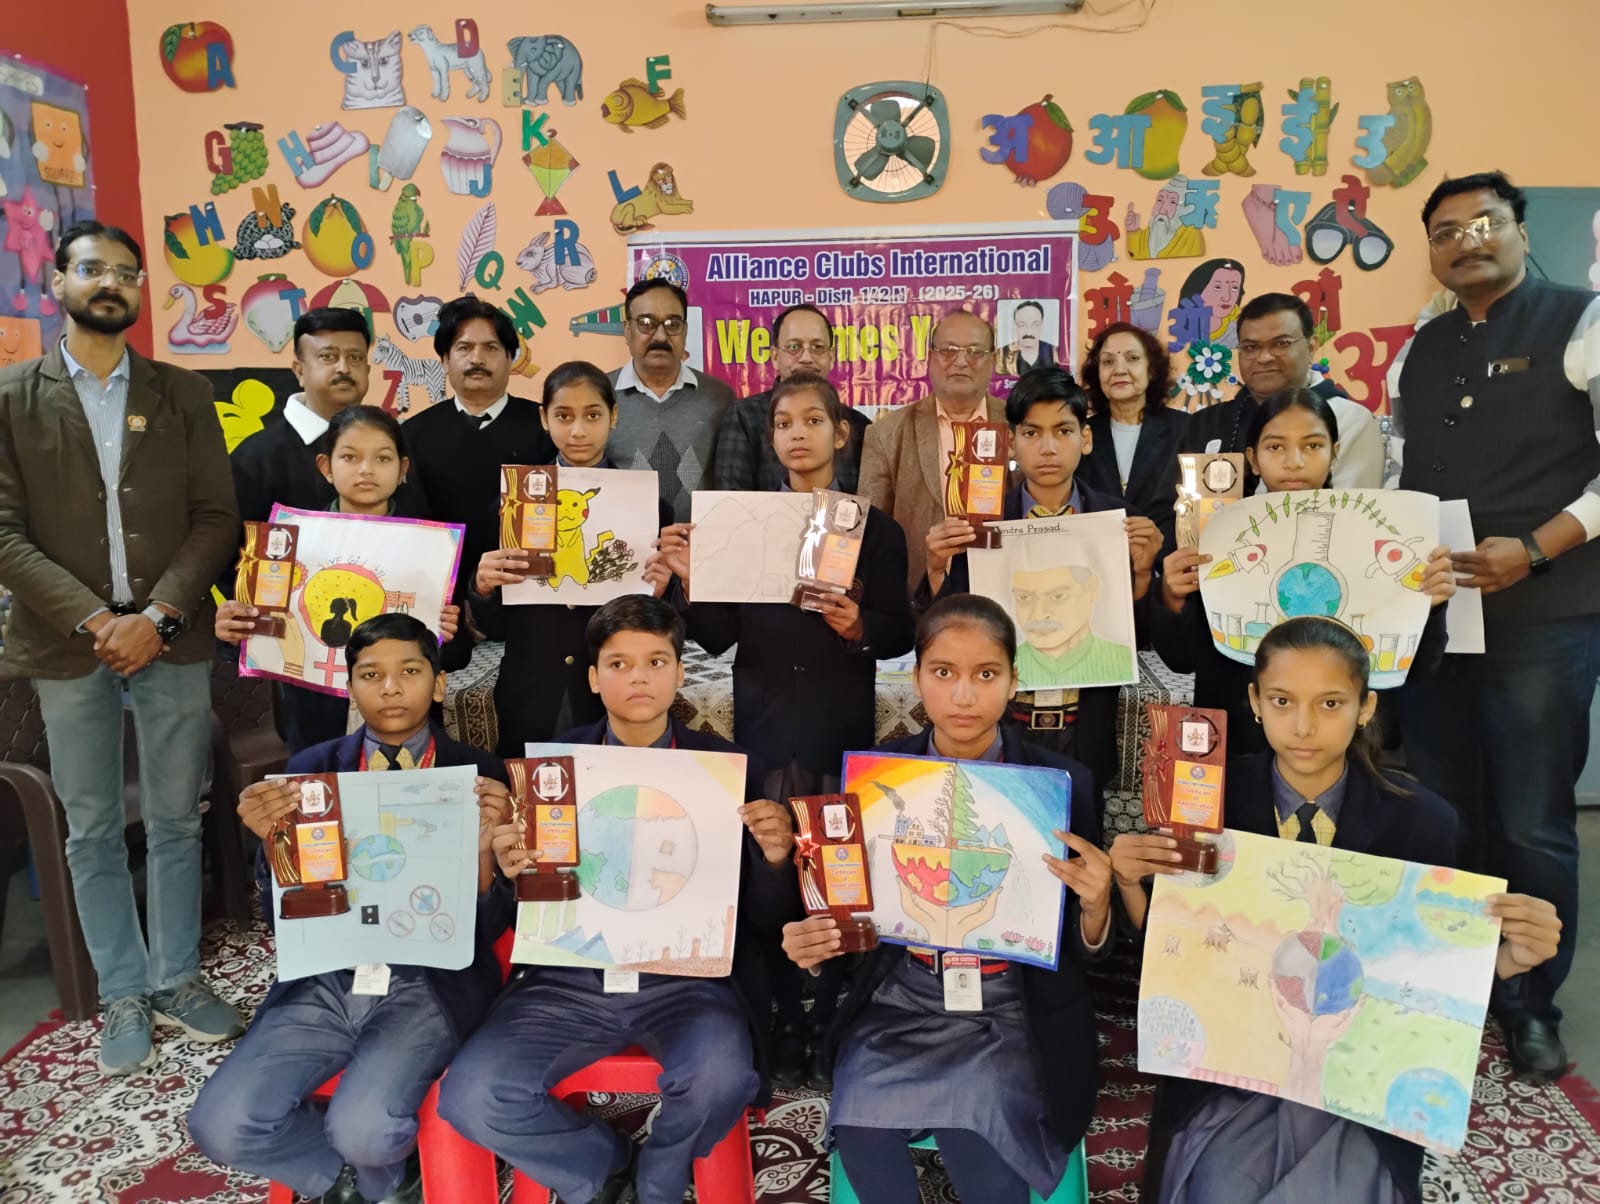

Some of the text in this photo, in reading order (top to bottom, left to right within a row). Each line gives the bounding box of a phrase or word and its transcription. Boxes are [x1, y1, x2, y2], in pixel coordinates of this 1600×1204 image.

[330, 31, 357, 74] C
[455, 18, 480, 58] D
[206, 43, 235, 89] A
[646, 55, 672, 93] F
[521, 109, 549, 151] K
[980, 114, 1034, 165] अ
[1085, 113, 1152, 169] आ
[1352, 115, 1395, 169] उ
[204, 130, 234, 175] G
[276, 130, 315, 177] H
[469, 163, 493, 198] J
[607, 169, 642, 204] L
[188, 201, 225, 246] M
[251, 183, 282, 229] N
[351, 232, 374, 269] O
[554, 219, 582, 266] R
[706, 253, 809, 281] Alliance
[815, 250, 885, 280] Clubs
[890, 245, 1051, 278] International
[411, 241, 434, 287] P
[475, 251, 502, 291] Q
[203, 285, 226, 320] S
[279, 288, 307, 321] T
[749, 289, 804, 306] HAPUR
[919, 285, 999, 301] (2025-26)
